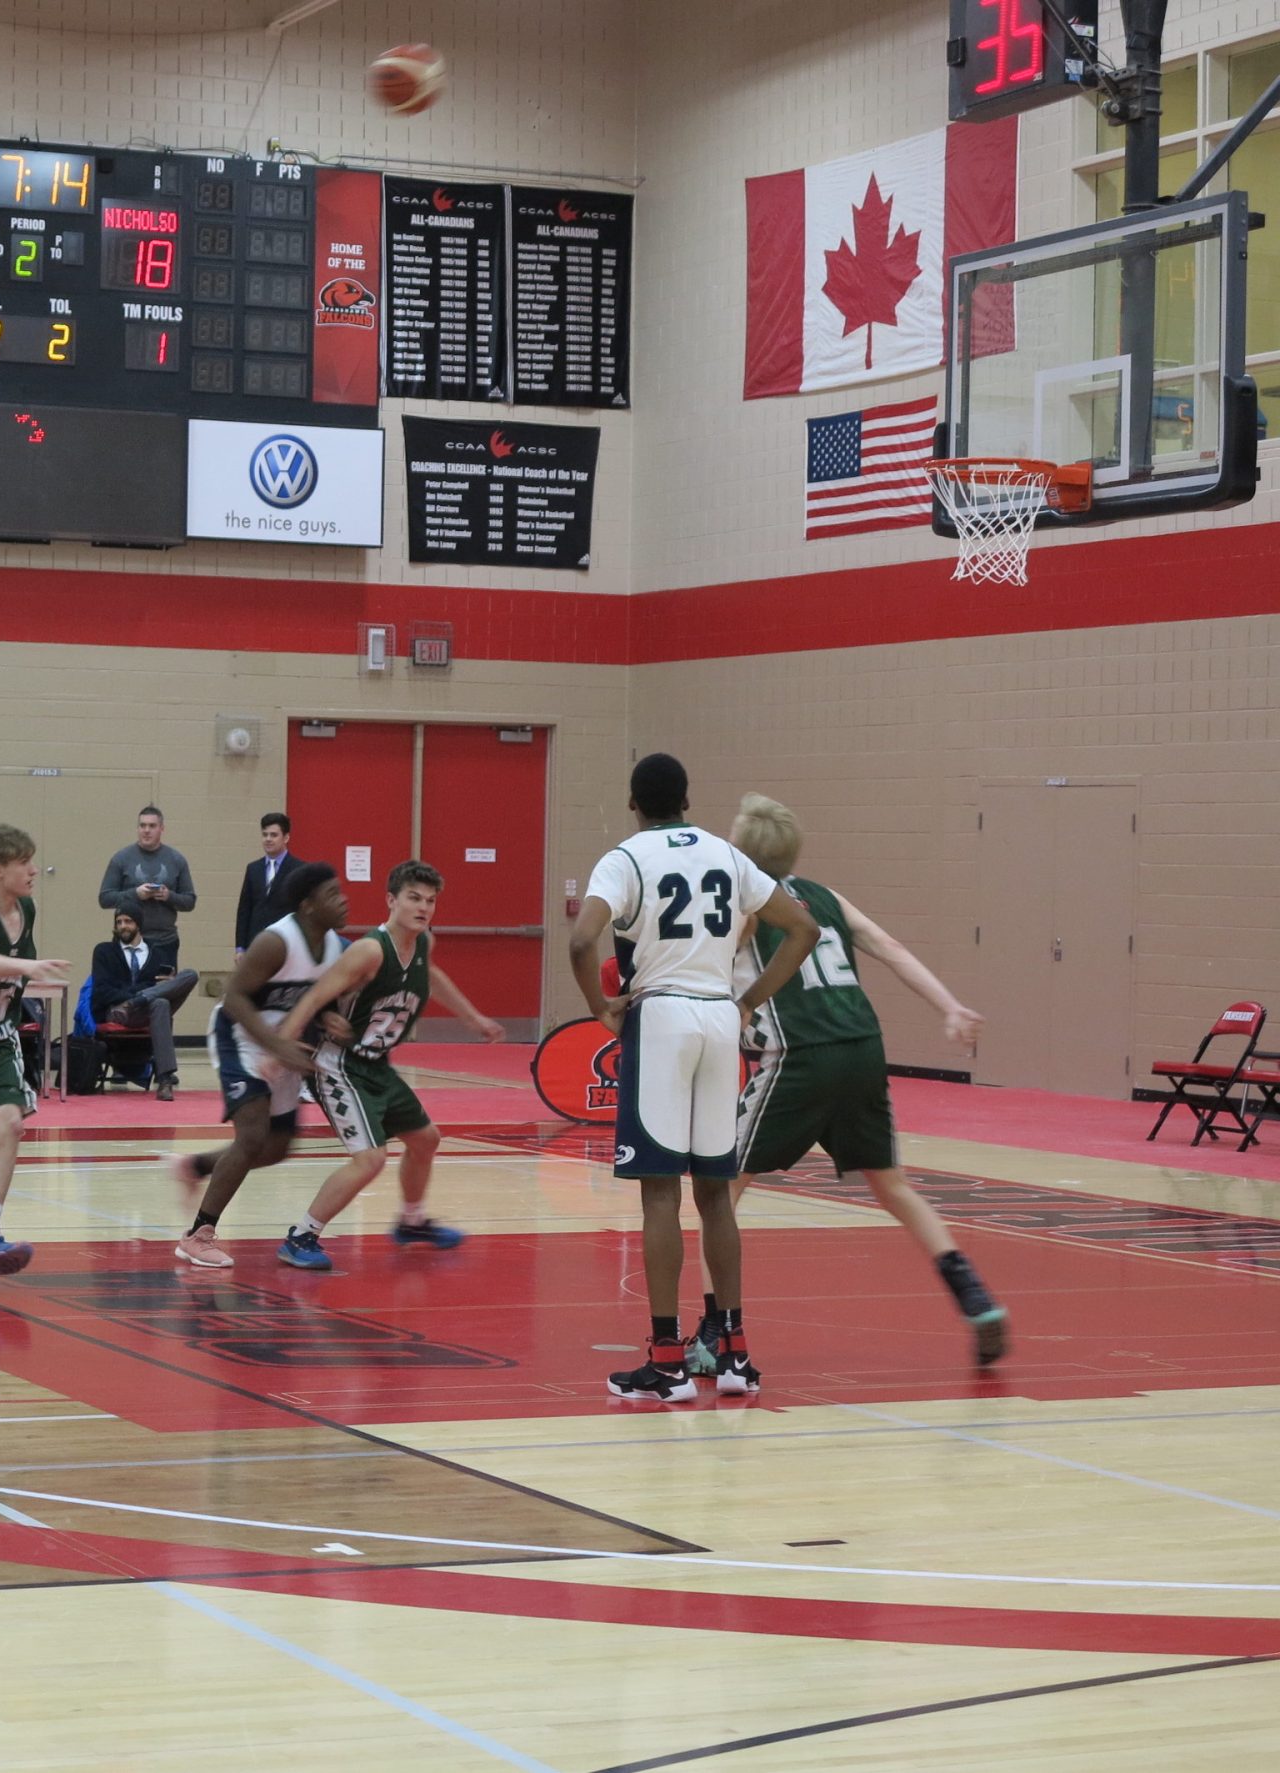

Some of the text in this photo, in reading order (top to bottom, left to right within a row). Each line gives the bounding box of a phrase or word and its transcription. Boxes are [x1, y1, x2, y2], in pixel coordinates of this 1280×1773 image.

[975, 0, 1042, 93] 35
[155, 166, 161, 177] B
[208, 159, 224, 173] NO
[256, 163, 263, 176] F
[279, 164, 301, 180] PTS
[1, 155, 89, 207] 7:14
[154, 178, 161, 189] B
[11, 217, 45, 230] PERIOD
[104, 208, 178, 233] NICHOLSO
[411, 214, 474, 229] ALL-CANADIANS
[537, 225, 599, 239] ALL-CANADIANS
[56, 236, 62, 246] P
[51, 248, 62, 259] TO
[331, 243, 363, 255] HOME
[15, 241, 37, 276] 2
[135, 240, 173, 288] 18
[328, 257, 365, 270] OF THE
[50, 299, 72, 314] TOL
[123, 304, 182, 321] TM FOULS
[320, 312, 371, 326] FALCONS
[49, 324, 69, 360] 2
[159, 332, 167, 364] 1
[445, 442, 557, 455] CCAA ACSC
[411, 461, 588, 481] COACHING EXCELLENCE National Coach of the Year
[225, 511, 341, 536] the nice guys.
[658, 868, 732, 940] 23
[799, 926, 860, 990] 12
